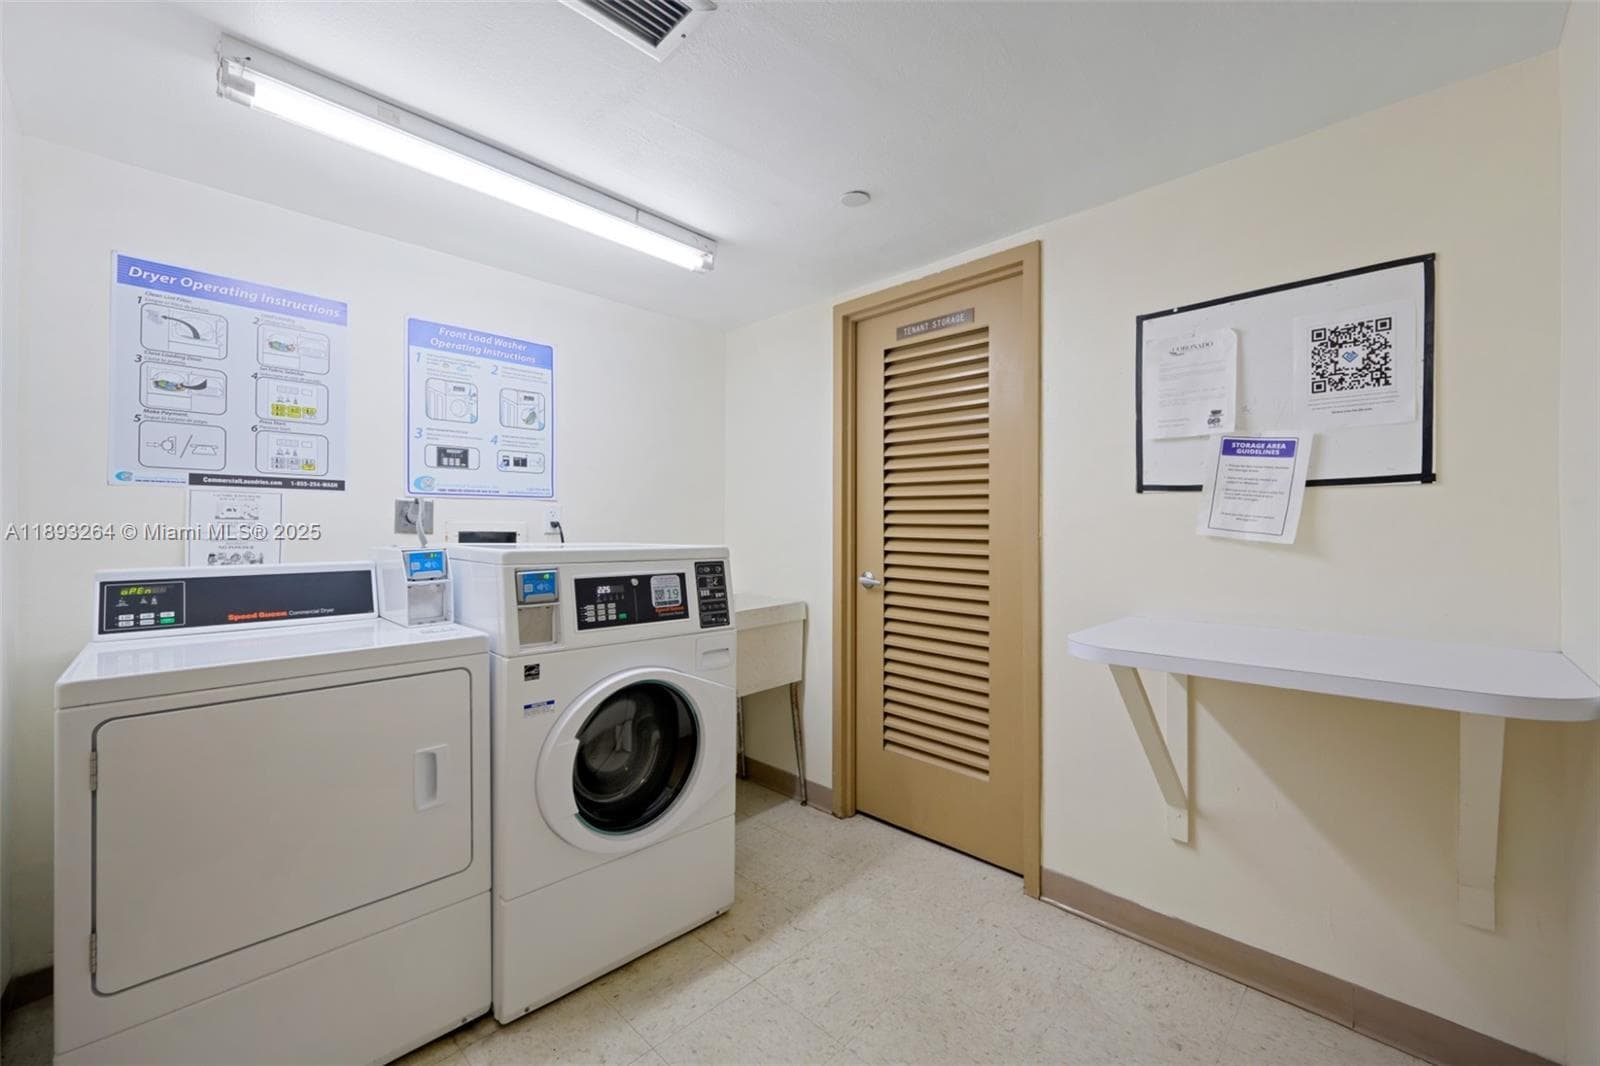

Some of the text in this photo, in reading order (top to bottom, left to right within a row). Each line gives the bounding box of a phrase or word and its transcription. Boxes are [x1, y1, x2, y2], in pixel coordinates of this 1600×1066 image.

[128, 266, 340, 318] Dryer Operating Instructions
[137, 296, 142, 304] 1
[252, 317, 259, 325] 2
[903, 313, 966, 336] TENANT STORAGE
[439, 327, 528, 352] Front Load Washer
[430, 337, 537, 364] Operating Instructions
[134, 354, 142, 362] 3
[416, 352, 422, 363] 1
[491, 365, 499, 376] 2
[133, 414, 141, 422] 5
[414, 427, 423, 439] 3
[490, 435, 499, 445] 4
[203, 475, 283, 486] CommercialLaundries.com
[228, 612, 257, 621] Speed
